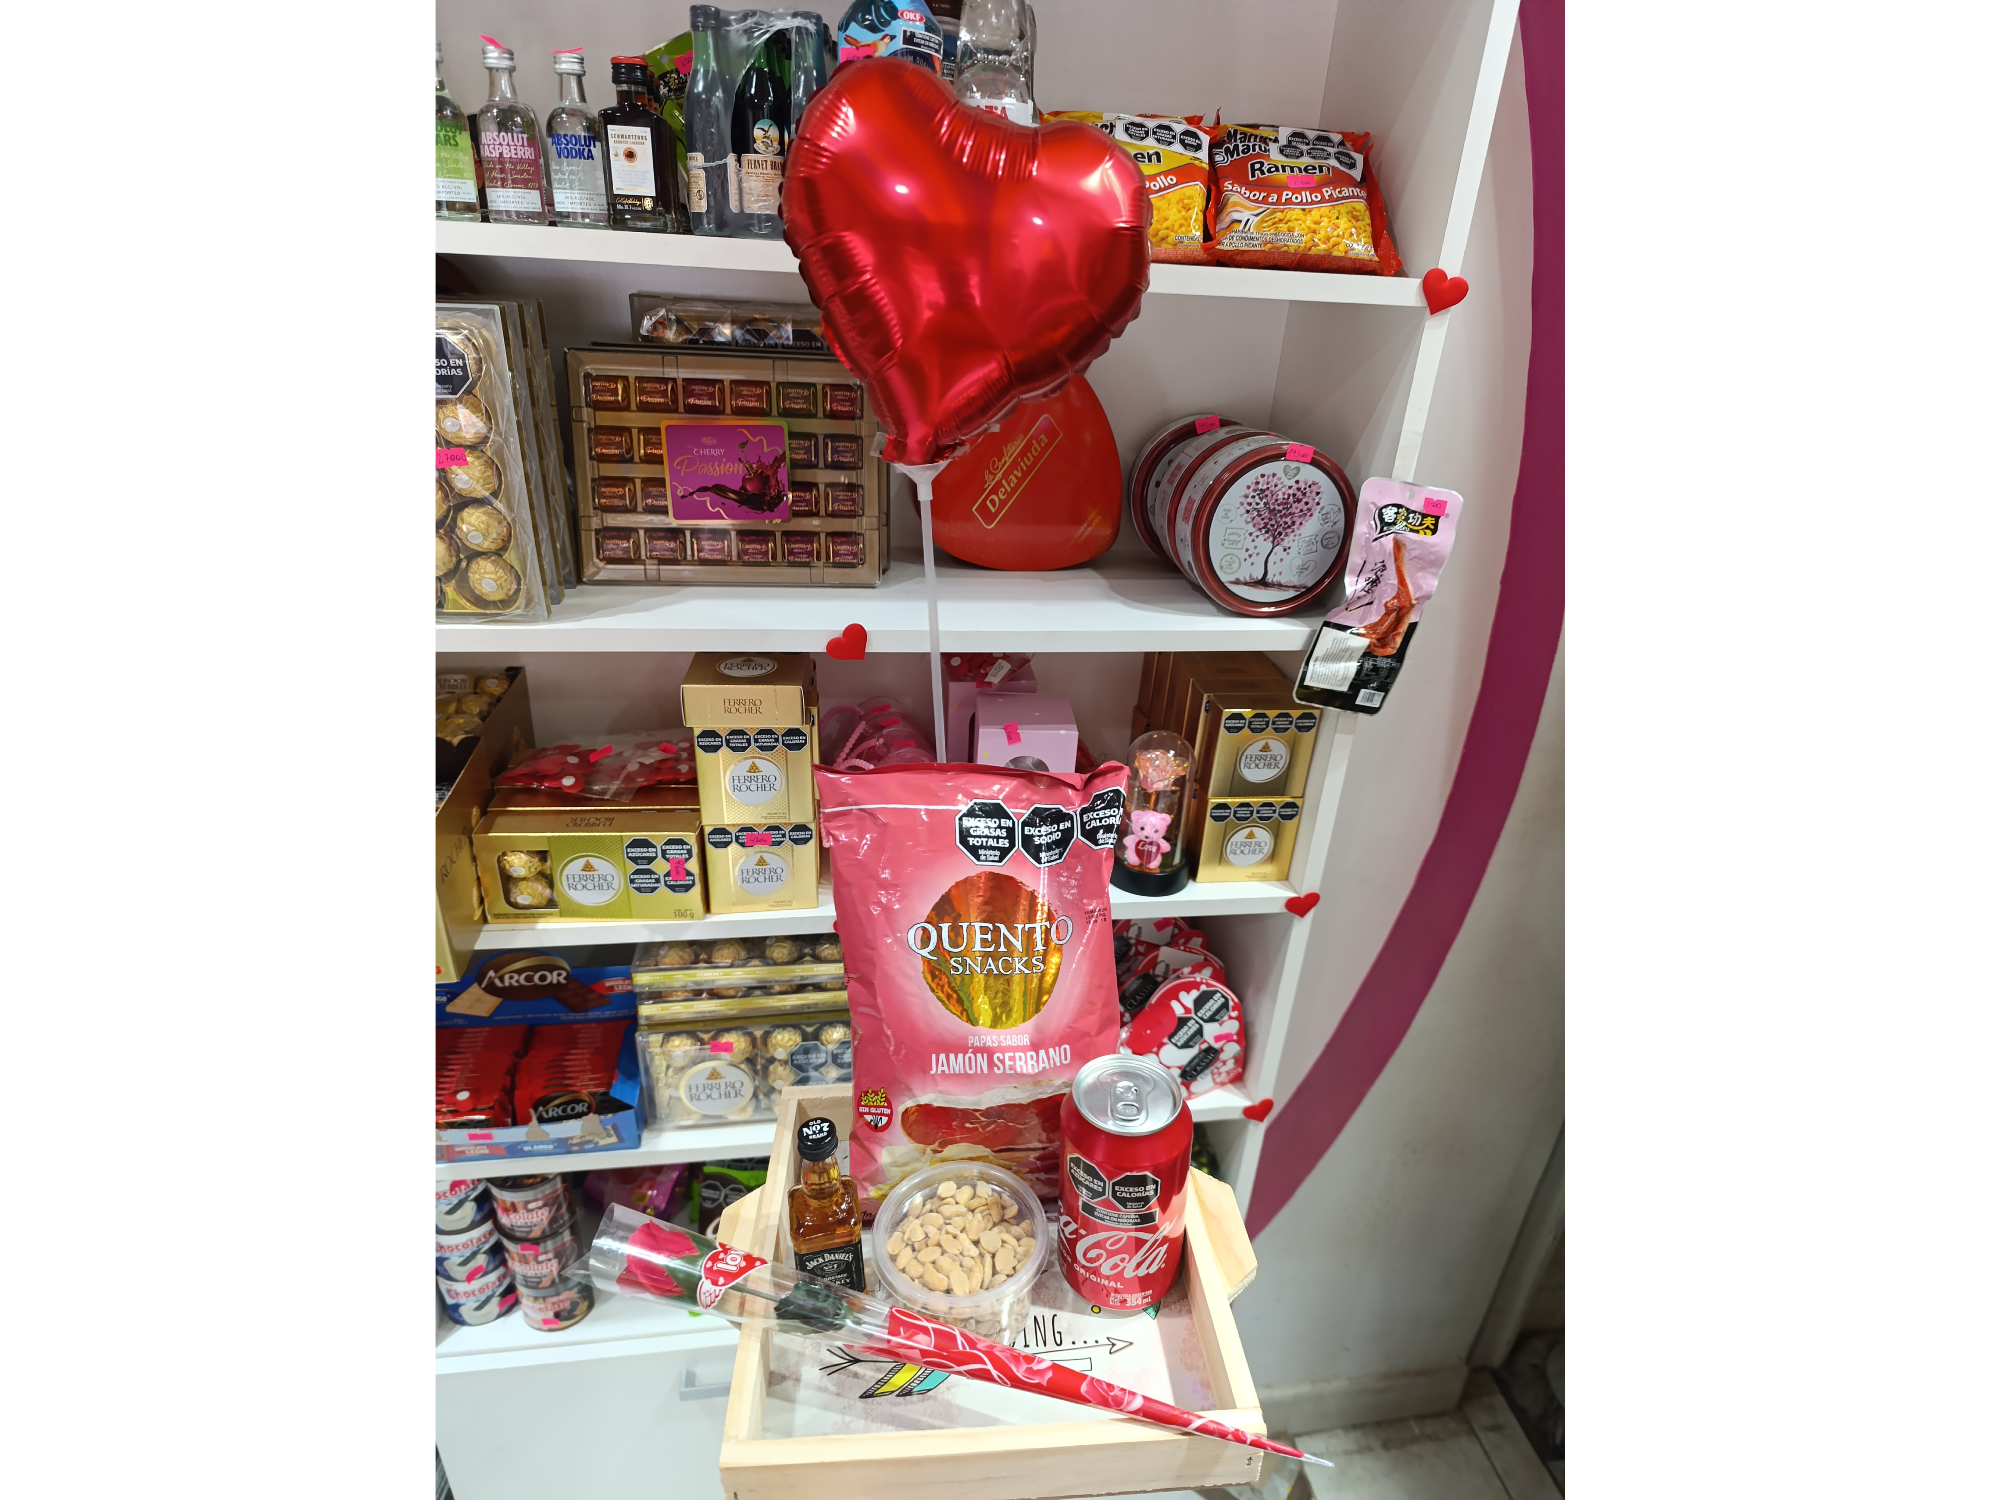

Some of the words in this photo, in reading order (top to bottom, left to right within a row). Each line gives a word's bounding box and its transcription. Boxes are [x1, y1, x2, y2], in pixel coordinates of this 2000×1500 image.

[903, 11, 921, 22] OKF
[435, 120, 462, 134] OLUT
[435, 134, 459, 148] ARS
[481, 132, 528, 146] ABSOLUT
[551, 133, 597, 149] ABSOLUT
[480, 145, 535, 160] RASPBERRI
[556, 147, 595, 161] VODKA
[1249, 159, 1332, 180] Ramen
[1223, 180, 1268, 203] Sabor
[1268, 193, 1277, 203] a
[1282, 191, 1322, 204] Pollo
[1322, 184, 1368, 202] Picante
[435, 367, 463, 376] ORÍAS
[693, 448, 725, 457] CHERRY
[674, 456, 744, 477] Passion
[986, 434, 1048, 513] Delaviuda
[984, 470, 994, 489] La
[723, 699, 762, 707] FERRERO
[724, 706, 763, 715] ROCHER
[1243, 761, 1281, 770] ROCHER
[1244, 754, 1283, 763] FERRERO
[732, 774, 777, 784] FERRERO
[733, 783, 778, 793] ROCHER
[1083, 808, 1118, 822] EXCESO
[962, 817, 999, 828] EXCESO
[1001, 818, 1013, 828] EN
[1024, 824, 1058, 836] EXCESO
[1059, 820, 1072, 830] EN
[970, 827, 1007, 837] GRASAS
[1034, 831, 1061, 845] SODIO
[967, 837, 1010, 847] TOTALES
[1138, 842, 1158, 851] Love
[1230, 840, 1267, 849] FERRERO
[1229, 848, 1265, 856] ROCHER
[566, 874, 614, 883] FERRERO
[741, 867, 784, 876] FERRERO
[568, 882, 616, 891] ROCHER
[741, 875, 783, 884] ROCHER
[907, 915, 1074, 960] QUENTO
[950, 955, 1045, 976] SNACKS
[481, 969, 568, 989] ARCOR
[1127, 982, 1156, 1010] CLASSIC
[1197, 998, 1216, 1017] EXCESO
[1214, 992, 1222, 1002] EN
[1171, 1025, 1189, 1044] EXCESO
[1187, 1018, 1196, 1028] EN
[968, 1035, 998, 1048] PAPAS
[1000, 1034, 1030, 1046] SABOR
[930, 1049, 988, 1075] JAMÓN
[993, 1043, 1071, 1075] SERRANO
[1187, 1050, 1215, 1081] CLASSIC
[688, 1080, 744, 1093] FERRERO
[689, 1089, 745, 1102] ROCHER
[537, 1102, 589, 1118] ARCOR
[870, 1107, 891, 1115] GLUTEN
[808, 1131, 828, 1140] BRAND
[1070, 1162, 1094, 1184] EXCESO
[1093, 1178, 1104, 1188] EN
[1070, 1169, 1103, 1192] AZÚCARES
[1117, 1190, 1154, 1198] CALORÍAS
[806, 1256, 823, 1270] JACK
[824, 1252, 854, 1263] DANIEL'S
[1073, 1263, 1124, 1289] ORIGINAL
[1125, 1297, 1142, 1306] 354
